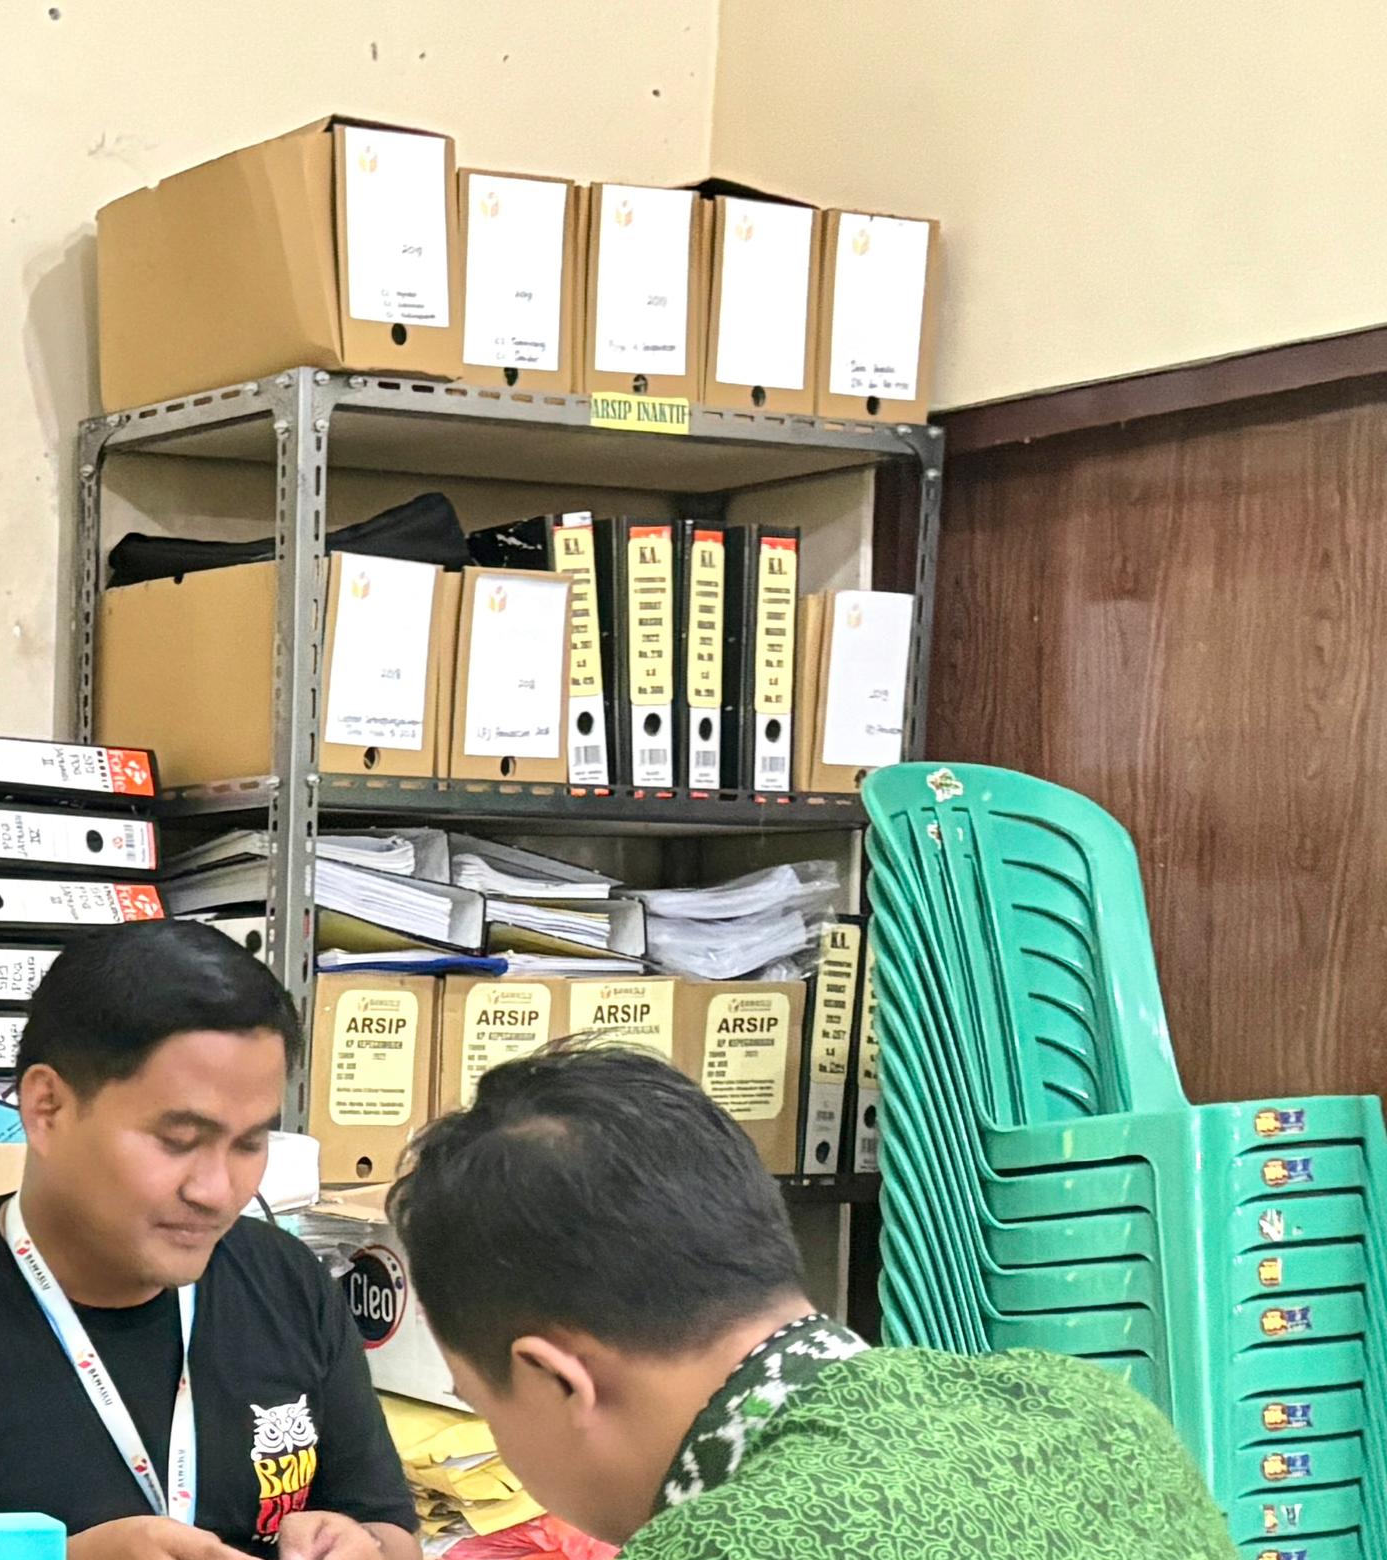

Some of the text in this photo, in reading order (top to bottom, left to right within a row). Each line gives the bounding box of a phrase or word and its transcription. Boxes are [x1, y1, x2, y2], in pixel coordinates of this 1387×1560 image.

[592, 399, 690, 424] ARSIP INAKTIF
[107, 750, 128, 793] Forte
[115, 884, 136, 922] Forte
[346, 1017, 407, 1034] ARSIP
[476, 1010, 539, 1026] ARSIP
[593, 1003, 651, 1024] ARSIP
[717, 1017, 779, 1033] ARSIP
[27, 1253, 51, 1291] BAWASLU
[350, 1272, 394, 1323] Cleo
[88, 1367, 114, 1406] BAWASLU
